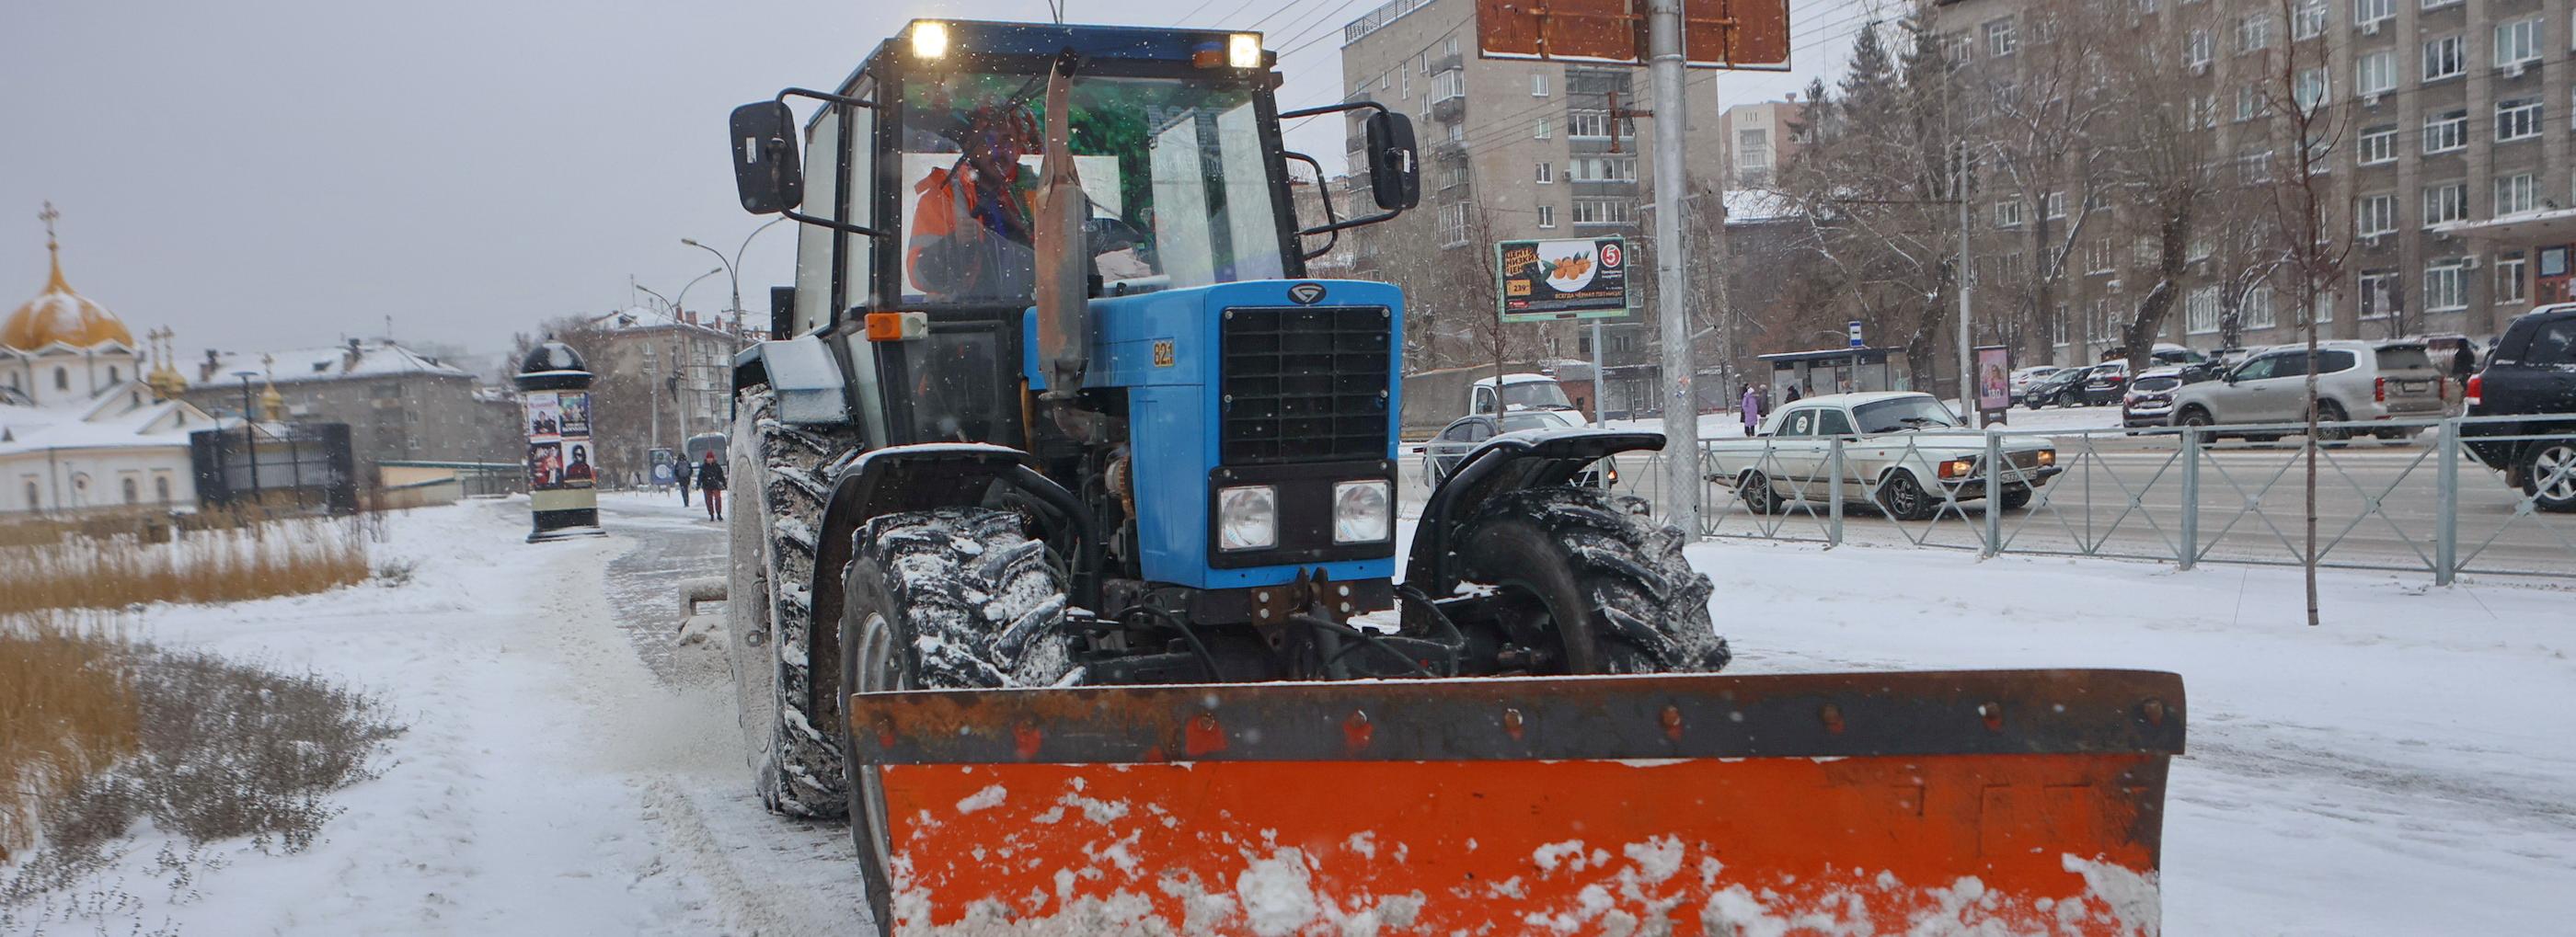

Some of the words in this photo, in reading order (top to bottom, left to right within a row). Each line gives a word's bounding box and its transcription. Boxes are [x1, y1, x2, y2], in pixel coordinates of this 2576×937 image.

[1506, 253, 1540, 266] НИЗКИХ
[1606, 246, 1616, 263] 5
[1506, 264, 1524, 275] ЦЕН
[1154, 342, 1173, 365] 82.1
